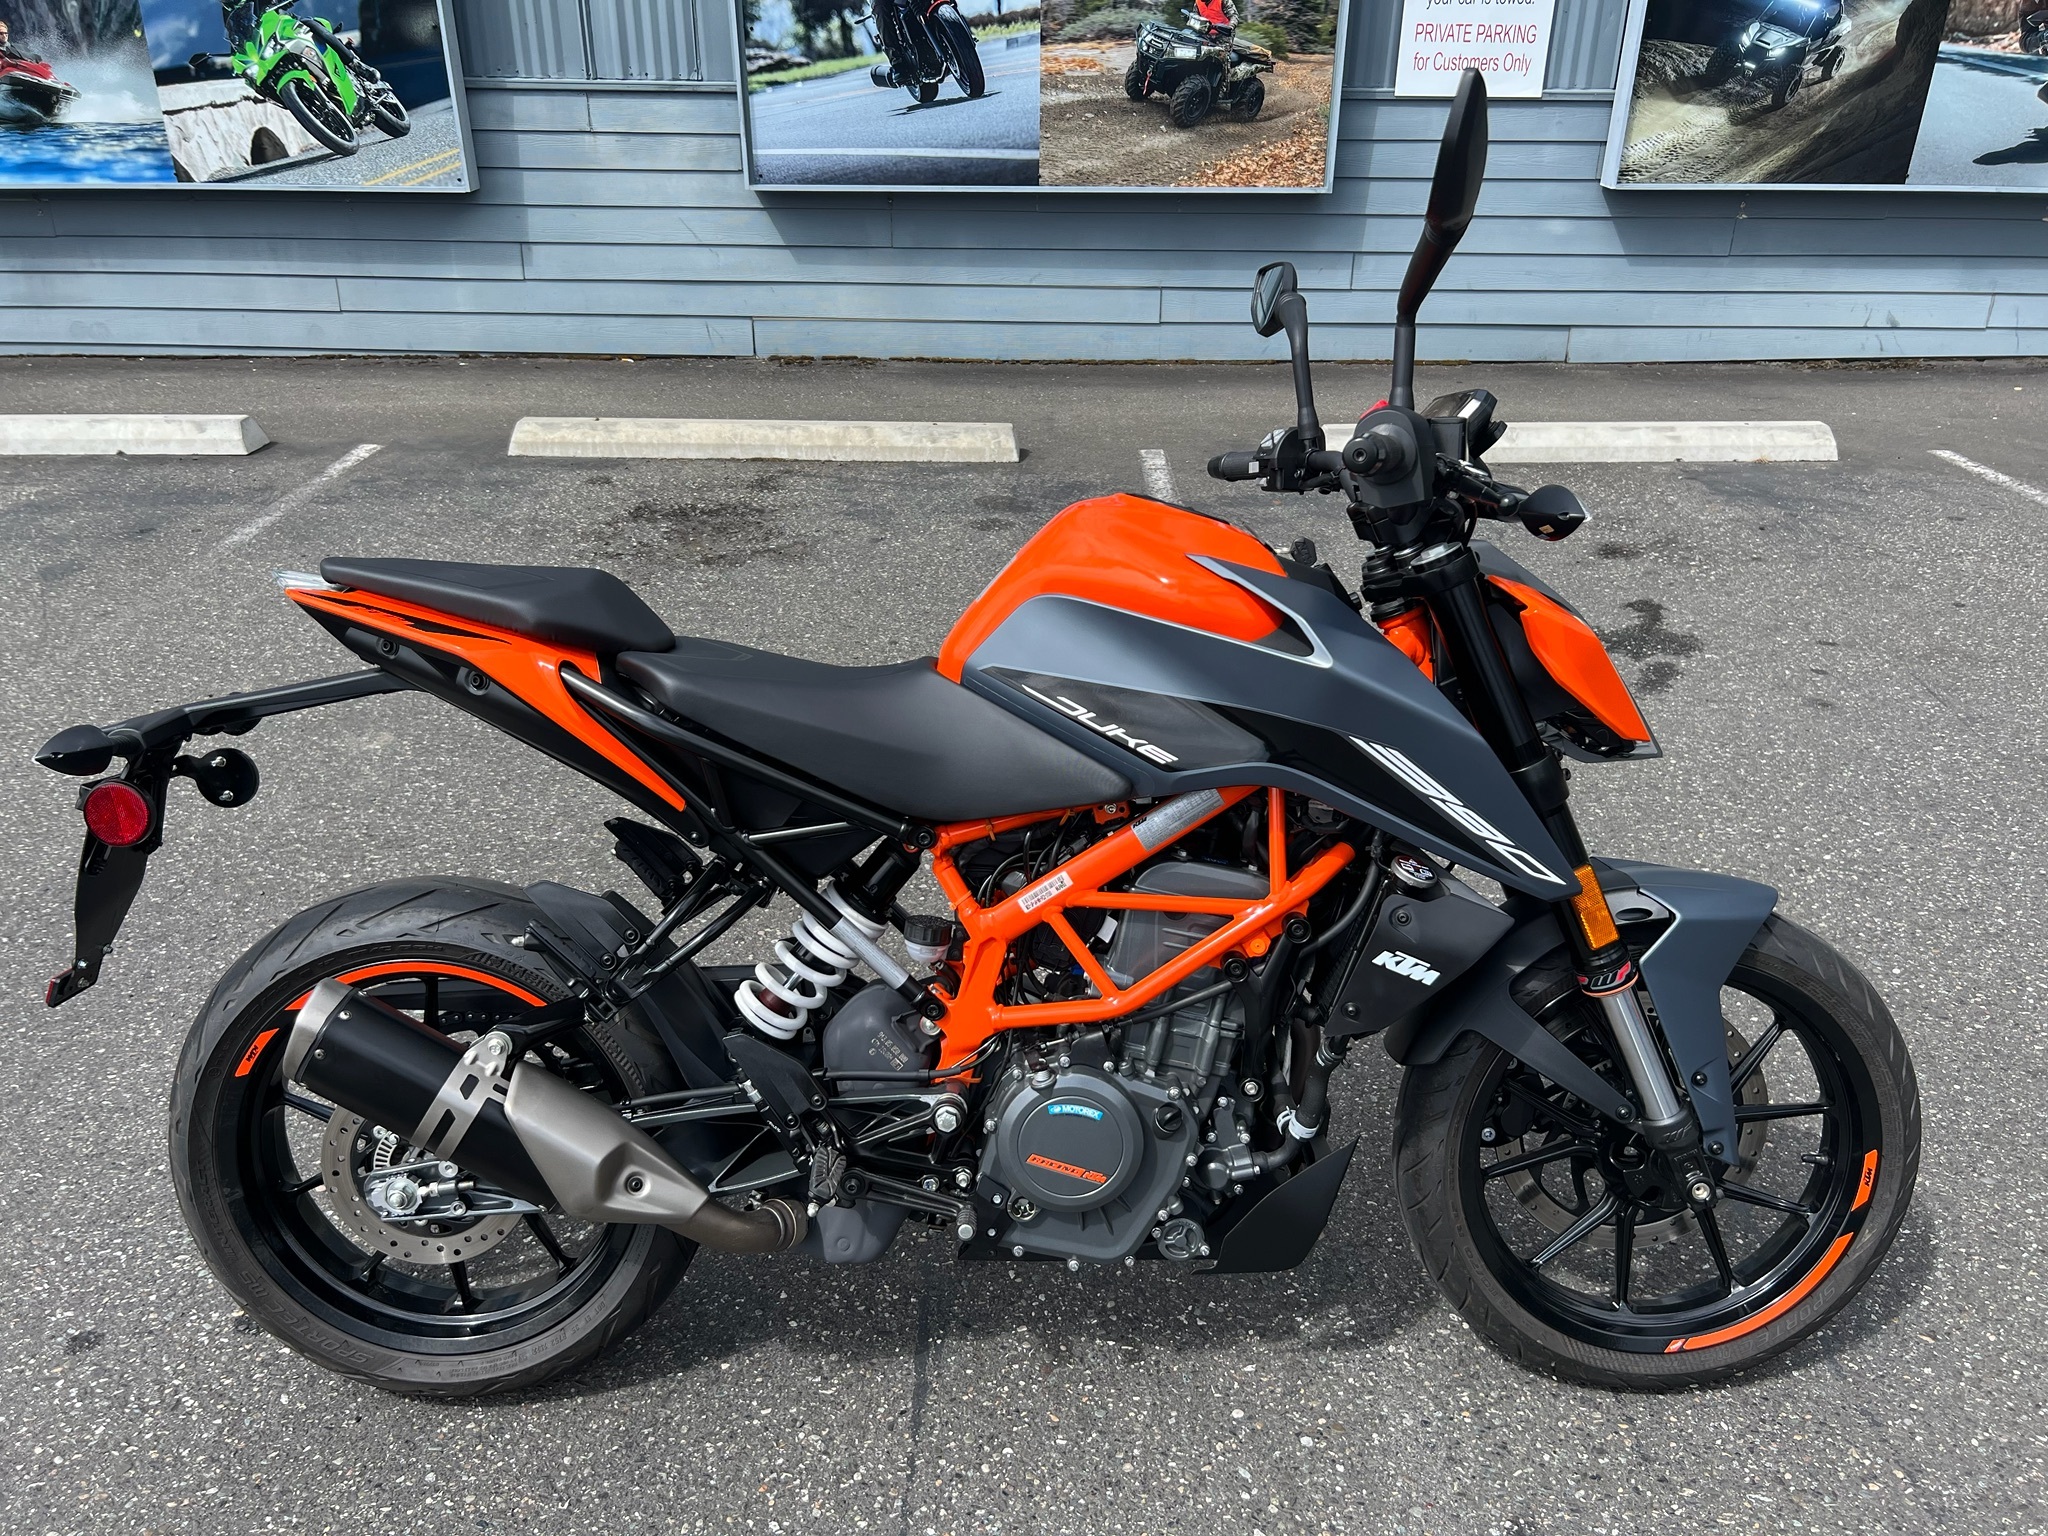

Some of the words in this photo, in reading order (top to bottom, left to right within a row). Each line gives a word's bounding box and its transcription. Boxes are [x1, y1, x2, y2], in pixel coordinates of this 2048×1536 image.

[1414, 23, 1473, 43] PRIVATE
[1475, 24, 1537, 44] PARKING
[1413, 51, 1430, 71] for
[1433, 51, 1499, 71] Customers
[1503, 52, 1532, 77] Only
[1021, 684, 1179, 764] DUKE
[1349, 736, 1567, 885] 390
[1371, 950, 1441, 986] KTM
[1590, 960, 1632, 990] WP
[1061, 1105, 1100, 1119] MOTOREX
[1863, 1167, 1874, 1188] KTM
